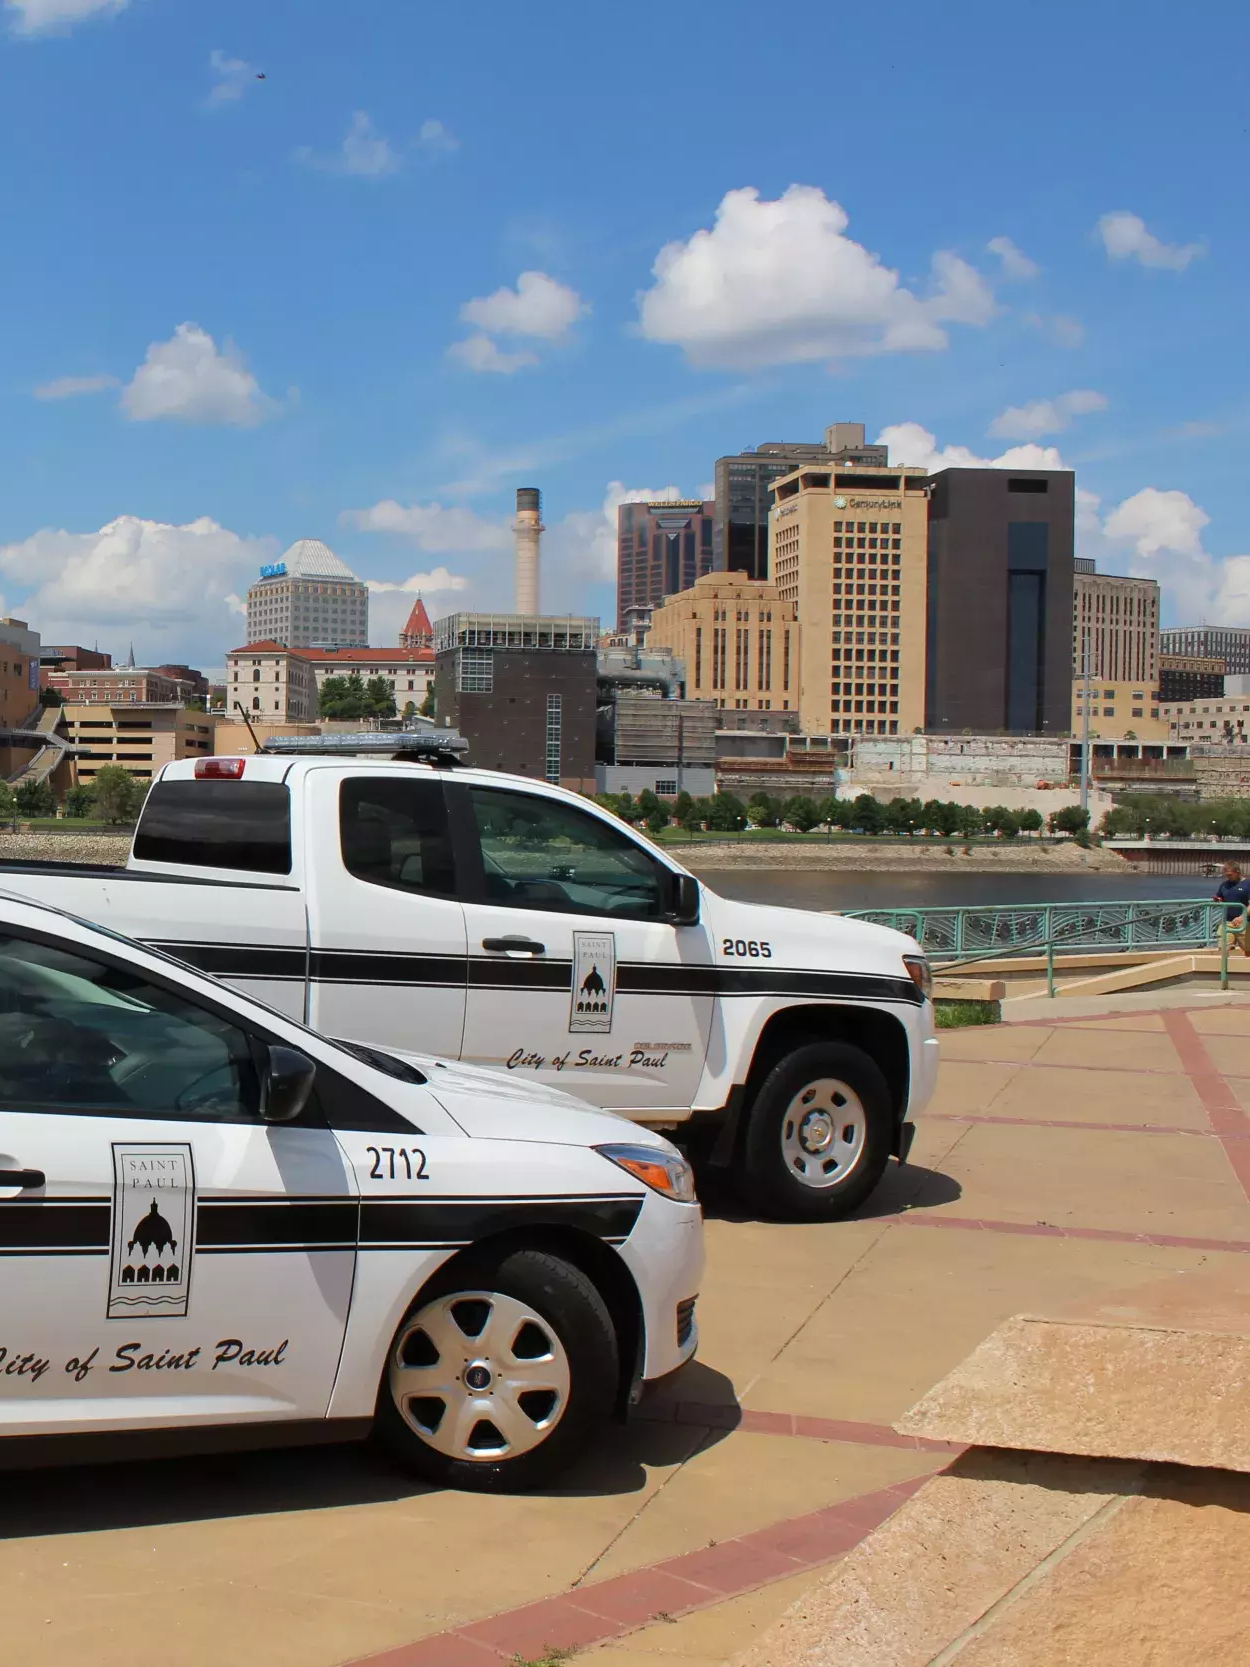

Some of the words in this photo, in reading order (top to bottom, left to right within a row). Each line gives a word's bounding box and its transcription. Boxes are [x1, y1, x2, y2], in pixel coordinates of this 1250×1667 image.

[581, 941, 607, 949] SAINT
[722, 938, 772, 958] 2065
[582, 951, 607, 959] PAUL
[506, 1048, 546, 1071] City
[552, 1050, 571, 1071] of
[574, 1049, 624, 1068] Saint
[627, 1050, 668, 1068] Paul
[130, 1160, 177, 1171] SAINT
[365, 1146, 430, 1180] 2712
[131, 1178, 178, 1189] PAUL
[64, 1346, 100, 1382] of
[108, 1342, 202, 1372] Saint
[211, 1338, 289, 1371] Paul
